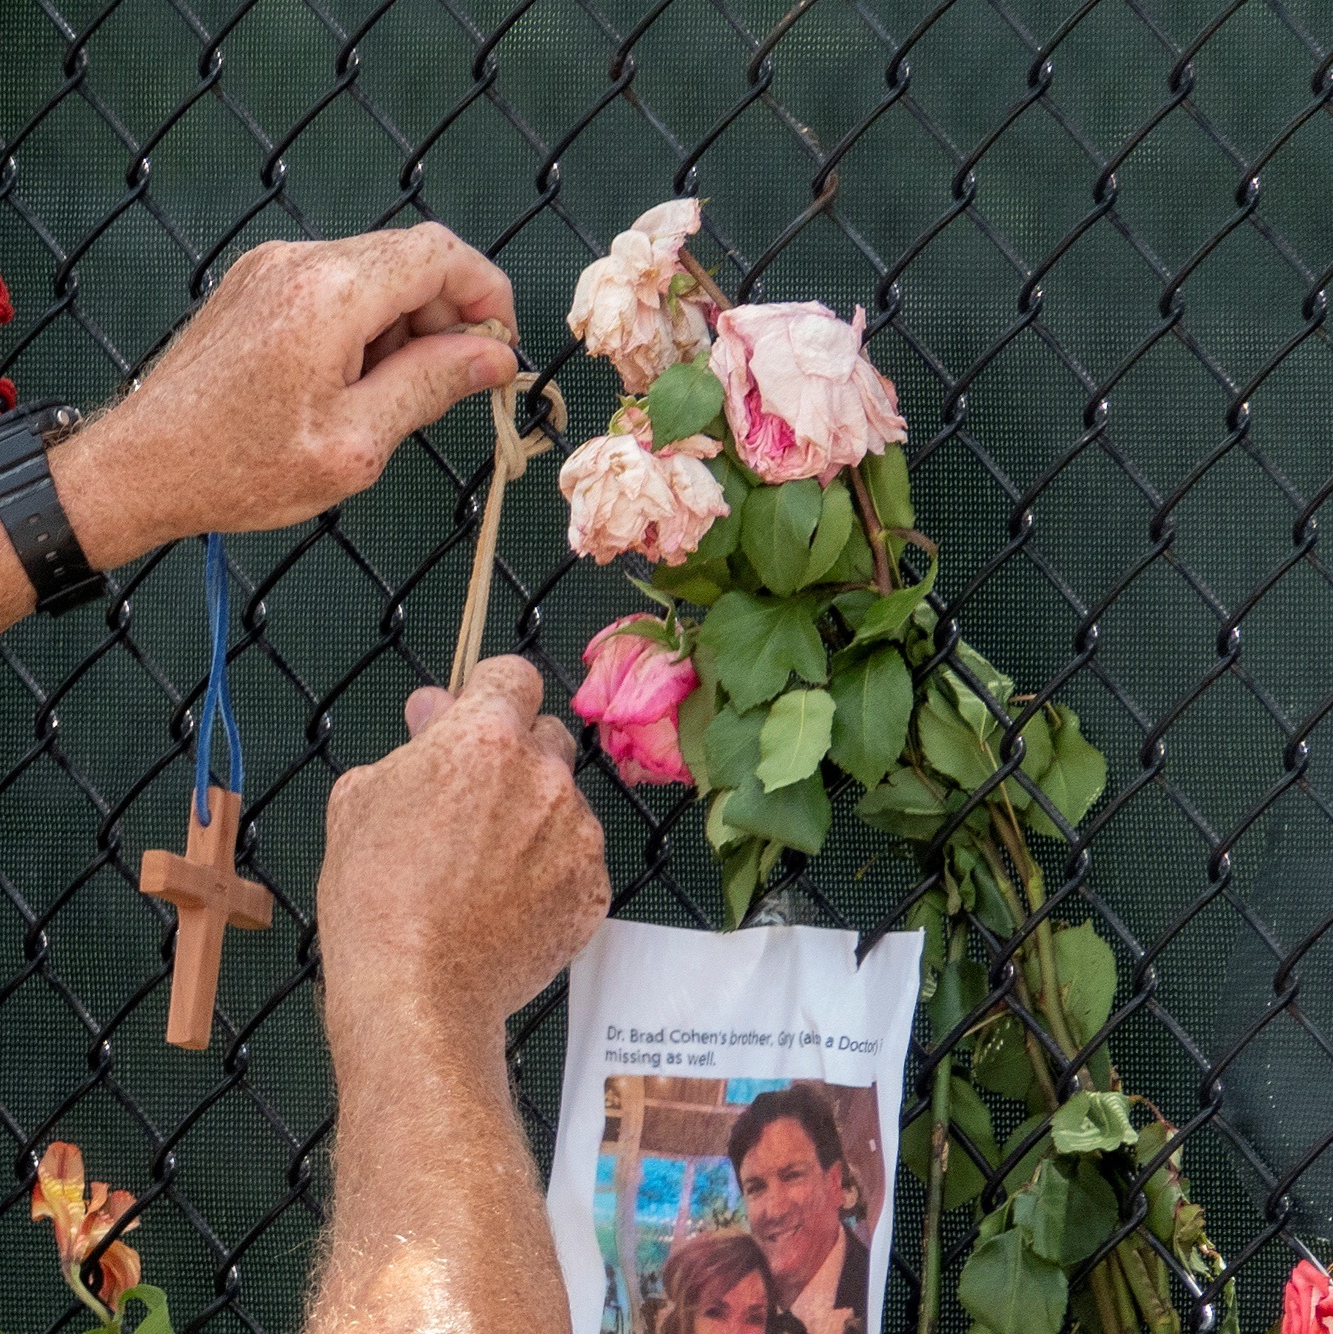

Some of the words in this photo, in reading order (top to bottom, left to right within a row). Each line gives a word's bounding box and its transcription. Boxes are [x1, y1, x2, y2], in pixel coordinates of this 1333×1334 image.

[607, 1025, 624, 1041] Dr.
[630, 1028, 665, 1043] Brad
[669, 1029, 727, 1045] Cohen's
[730, 1030, 774, 1048] brother,
[825, 1036, 834, 1048] a
[605, 1048, 662, 1068] missing
[666, 1052, 683, 1065] as
[687, 1050, 717, 1066] well.
